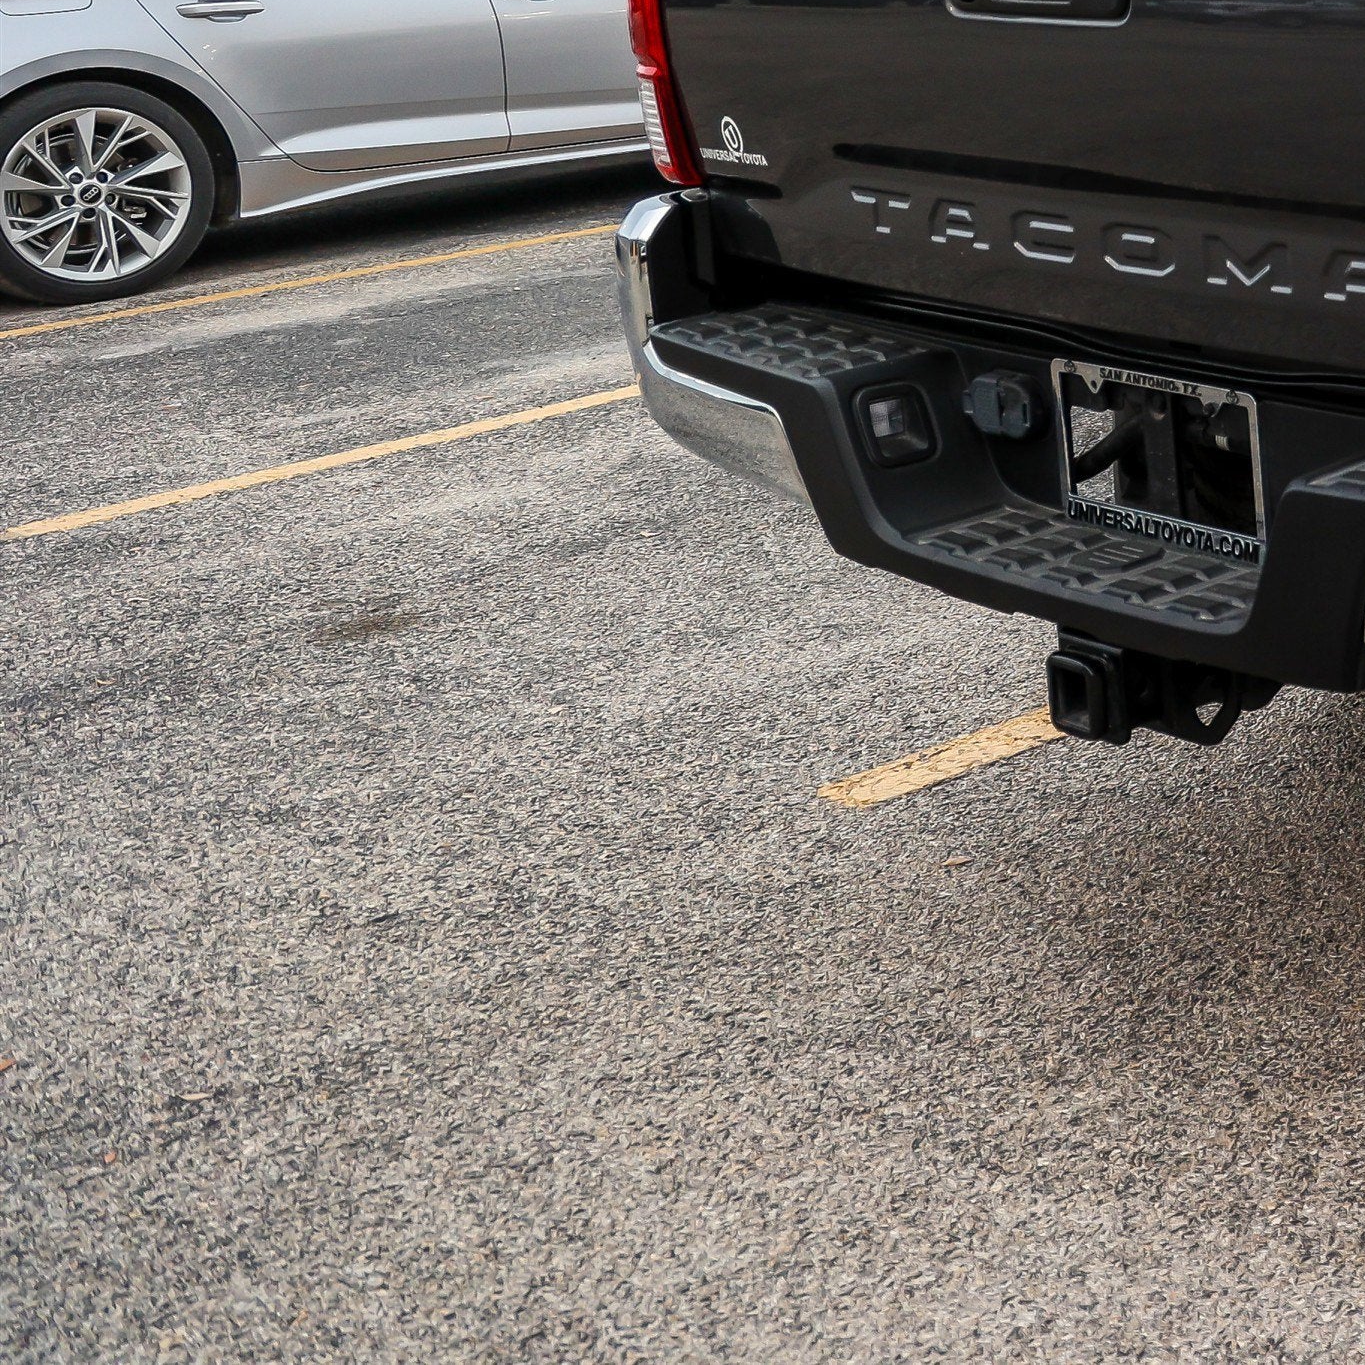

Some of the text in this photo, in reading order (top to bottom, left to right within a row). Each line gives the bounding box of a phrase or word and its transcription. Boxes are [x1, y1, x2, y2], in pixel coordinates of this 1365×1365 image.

[700, 148, 768, 166] UNIVERSAL TOYOTA
[1099, 367, 1123, 382] SAN
[1068, 500, 1260, 562] UNIVERSALTOYOTA.COM
